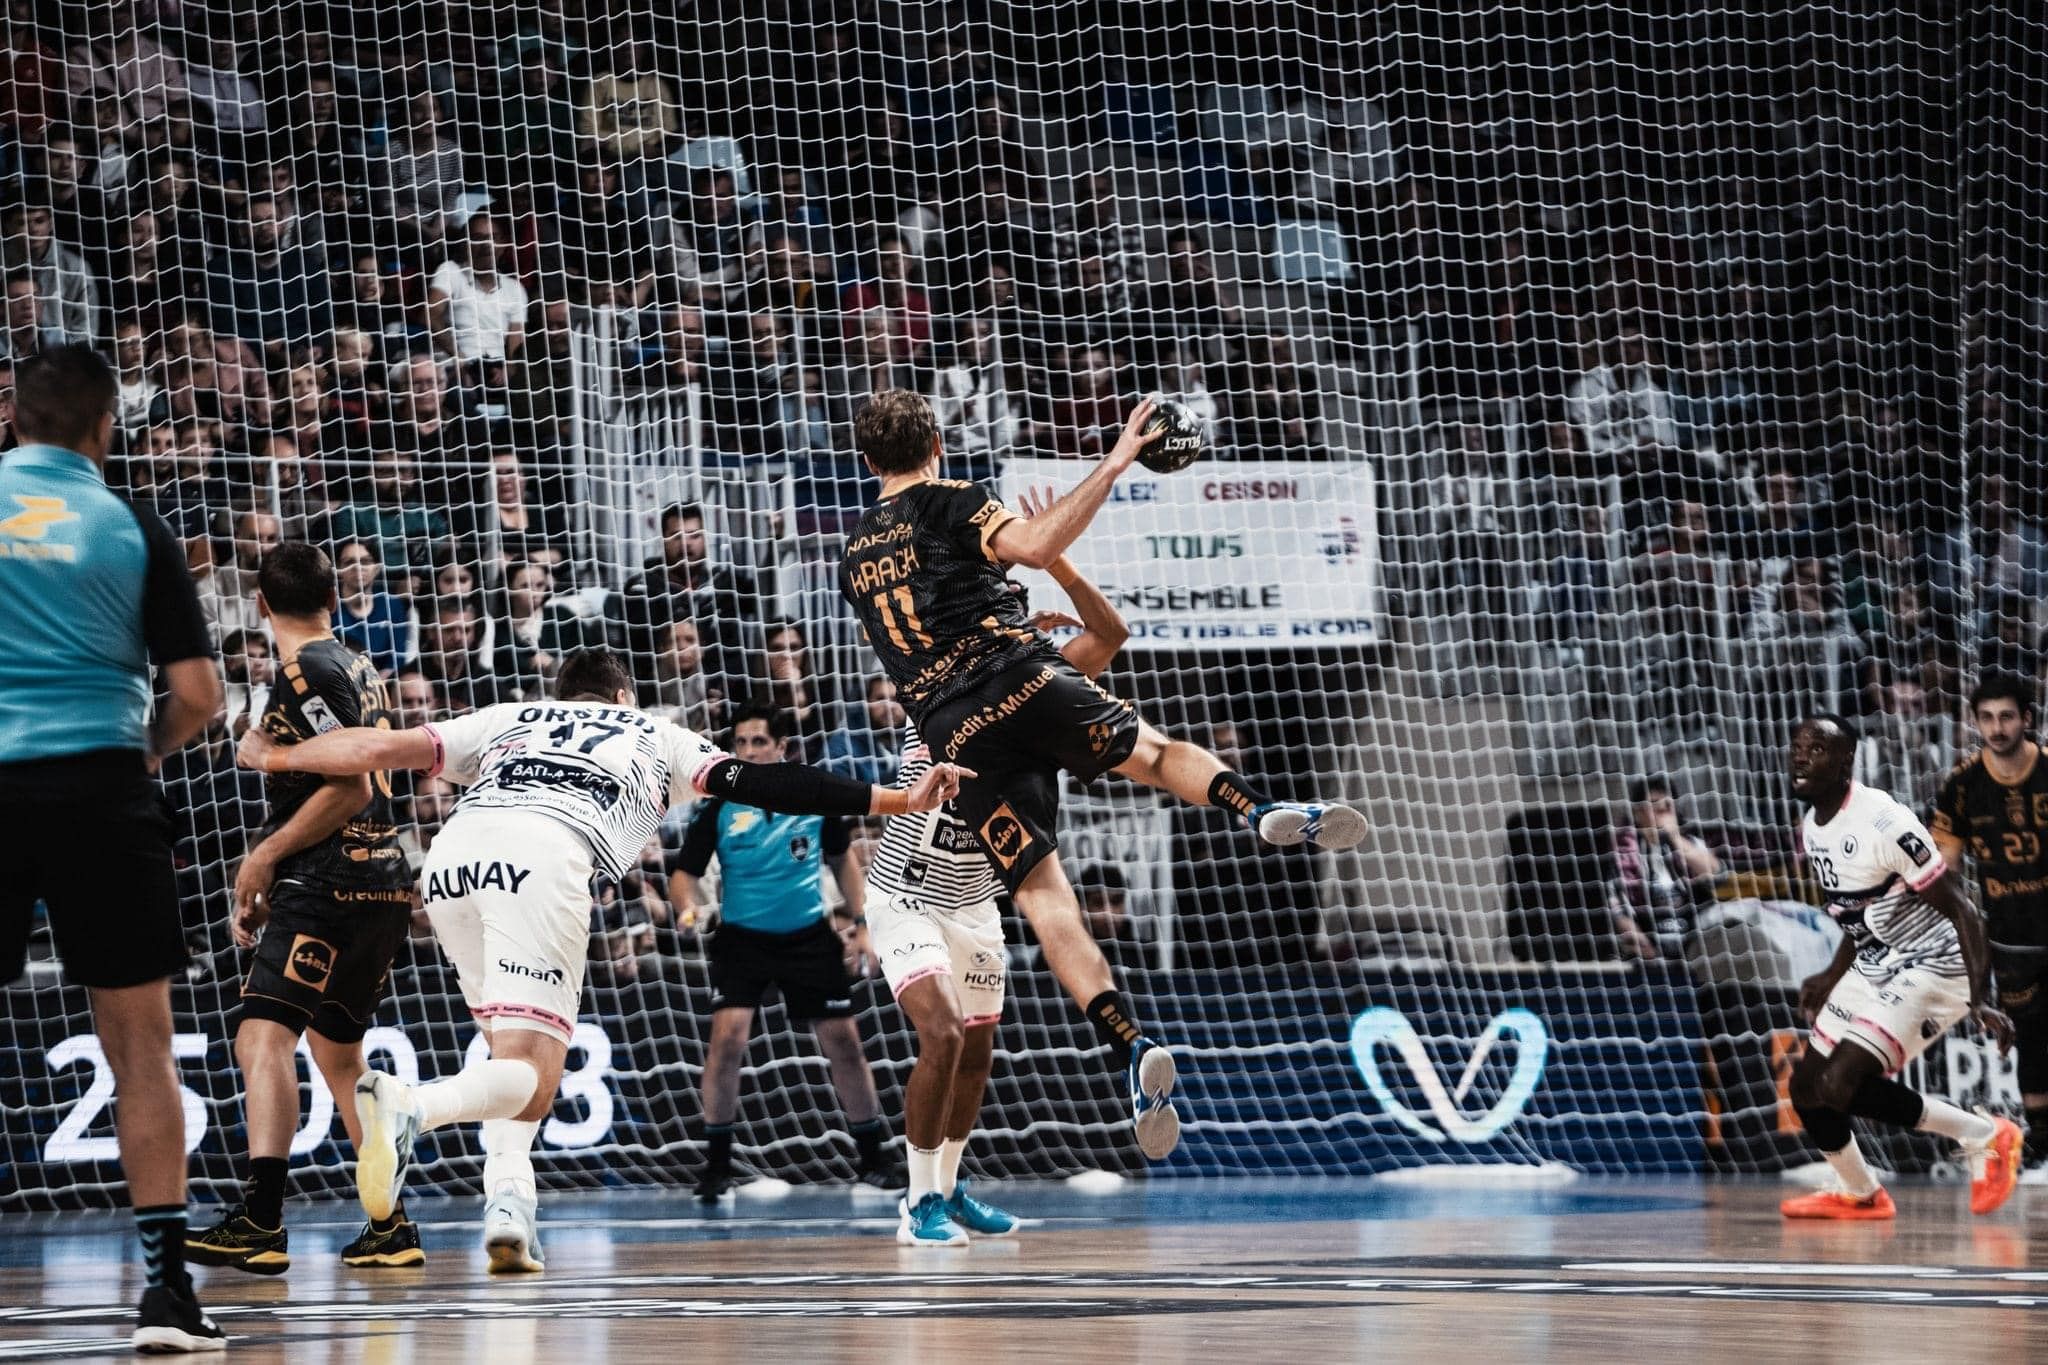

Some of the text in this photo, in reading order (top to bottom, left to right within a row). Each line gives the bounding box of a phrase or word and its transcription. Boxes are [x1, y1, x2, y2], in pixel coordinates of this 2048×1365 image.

[1203, 480, 1298, 501] CESSON
[1145, 534, 1244, 559] TOUS
[849, 543, 921, 599] KRAGH
[873, 584, 935, 657] 11
[945, 714, 988, 761] Crédit
[1000, 664, 1058, 716] Mutuel
[548, 721, 625, 755] 17
[422, 861, 532, 905] AUNAY
